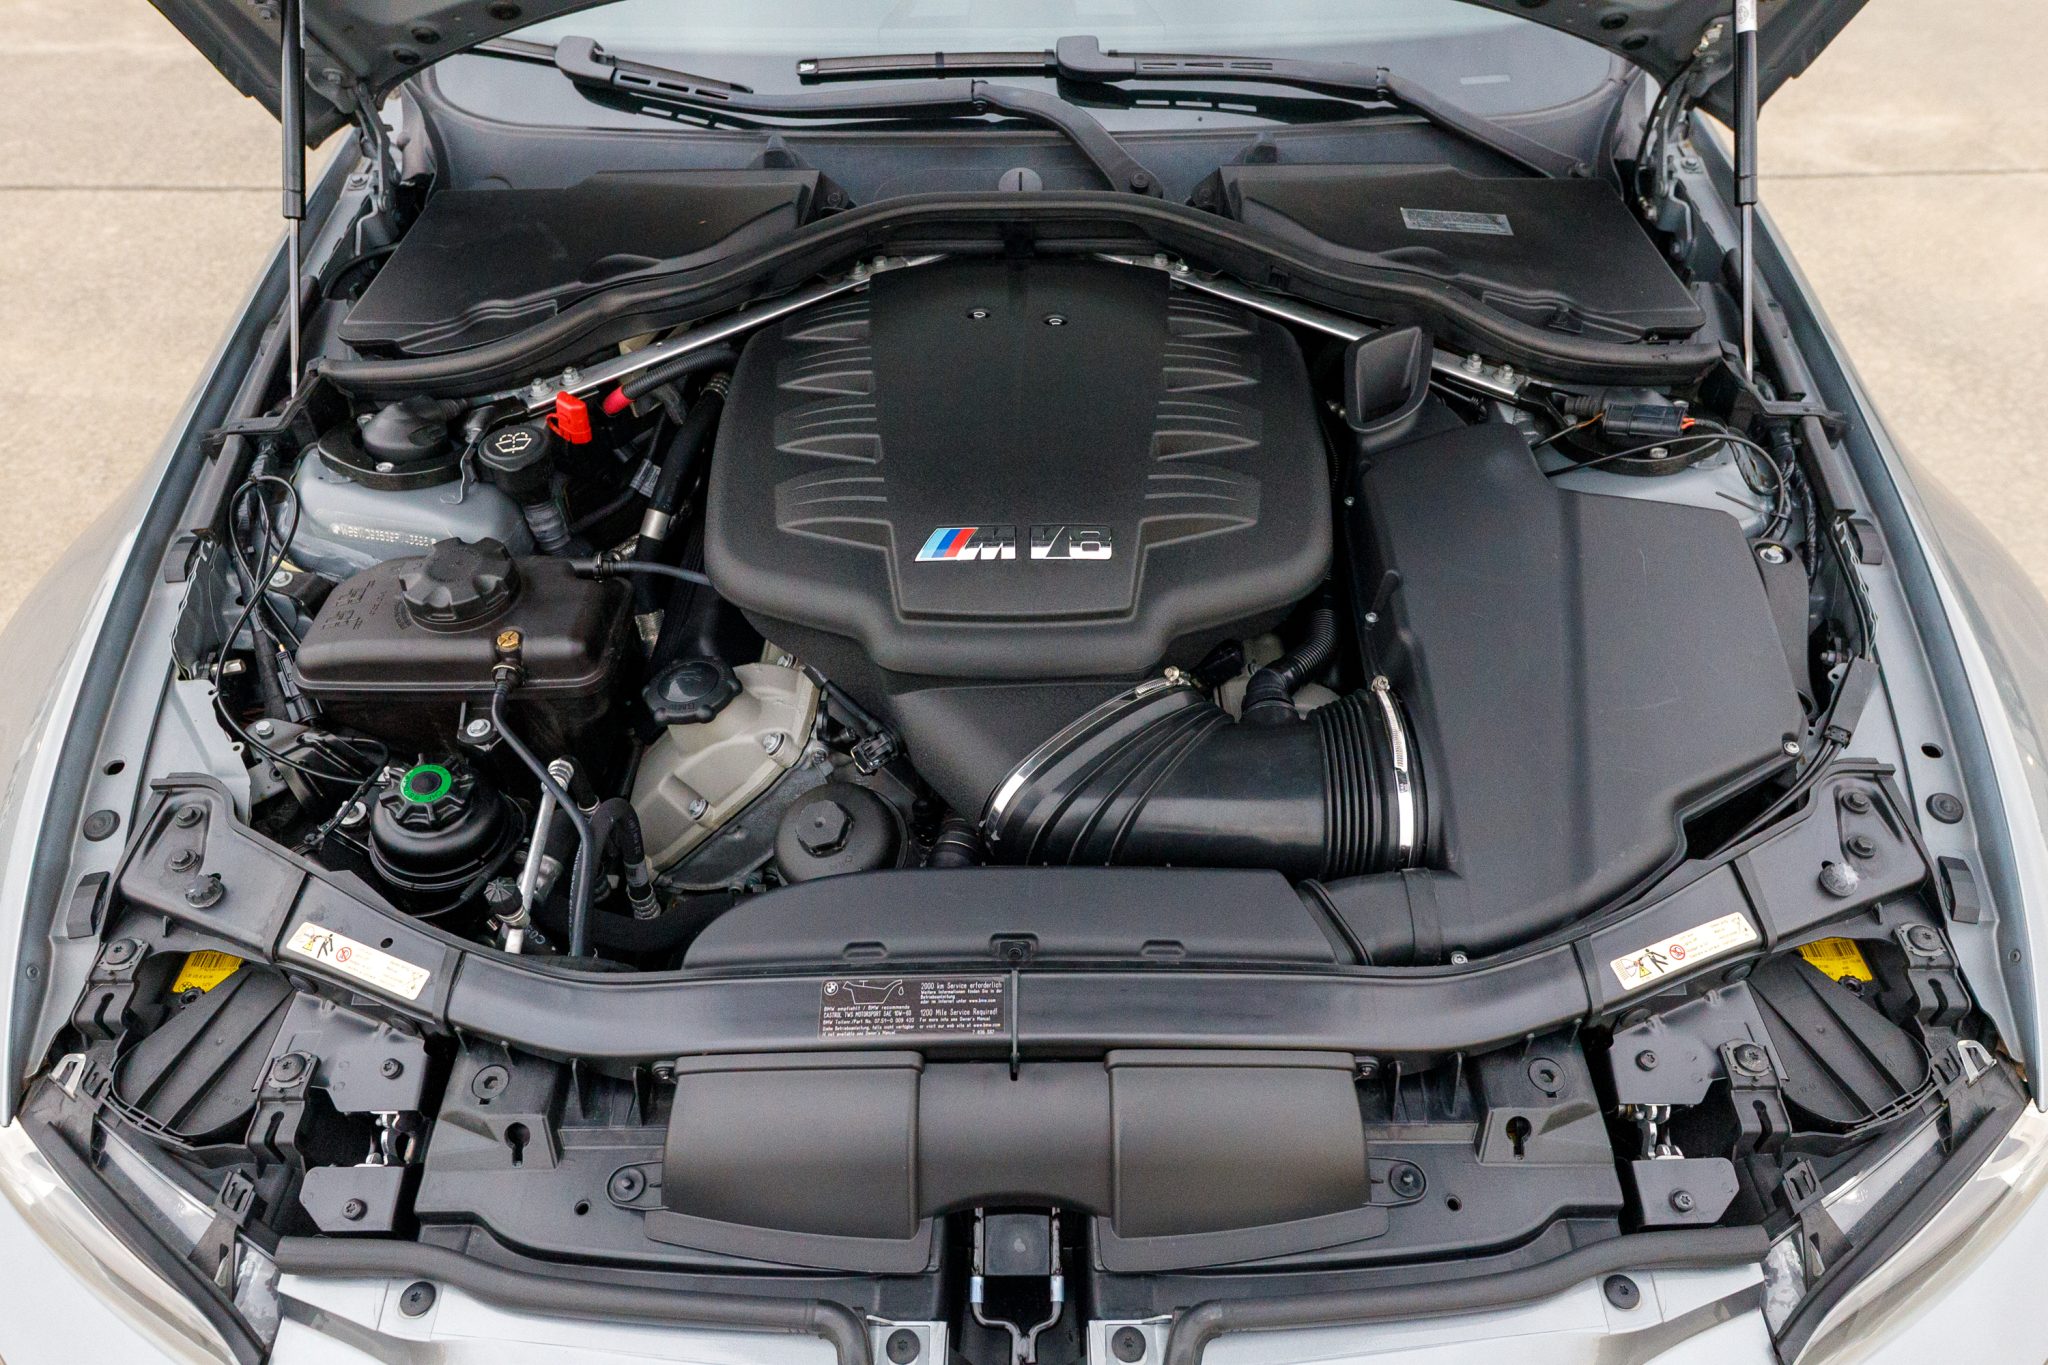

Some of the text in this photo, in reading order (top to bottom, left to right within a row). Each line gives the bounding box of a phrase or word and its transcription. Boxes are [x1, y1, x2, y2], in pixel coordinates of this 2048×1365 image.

[957, 525, 1113, 561] M V8
[921, 982, 935, 990] 2000
[970, 981, 1002, 989] erforderlich
[936, 1008, 947, 1016] Mile
[973, 1008, 998, 1016] Required!
